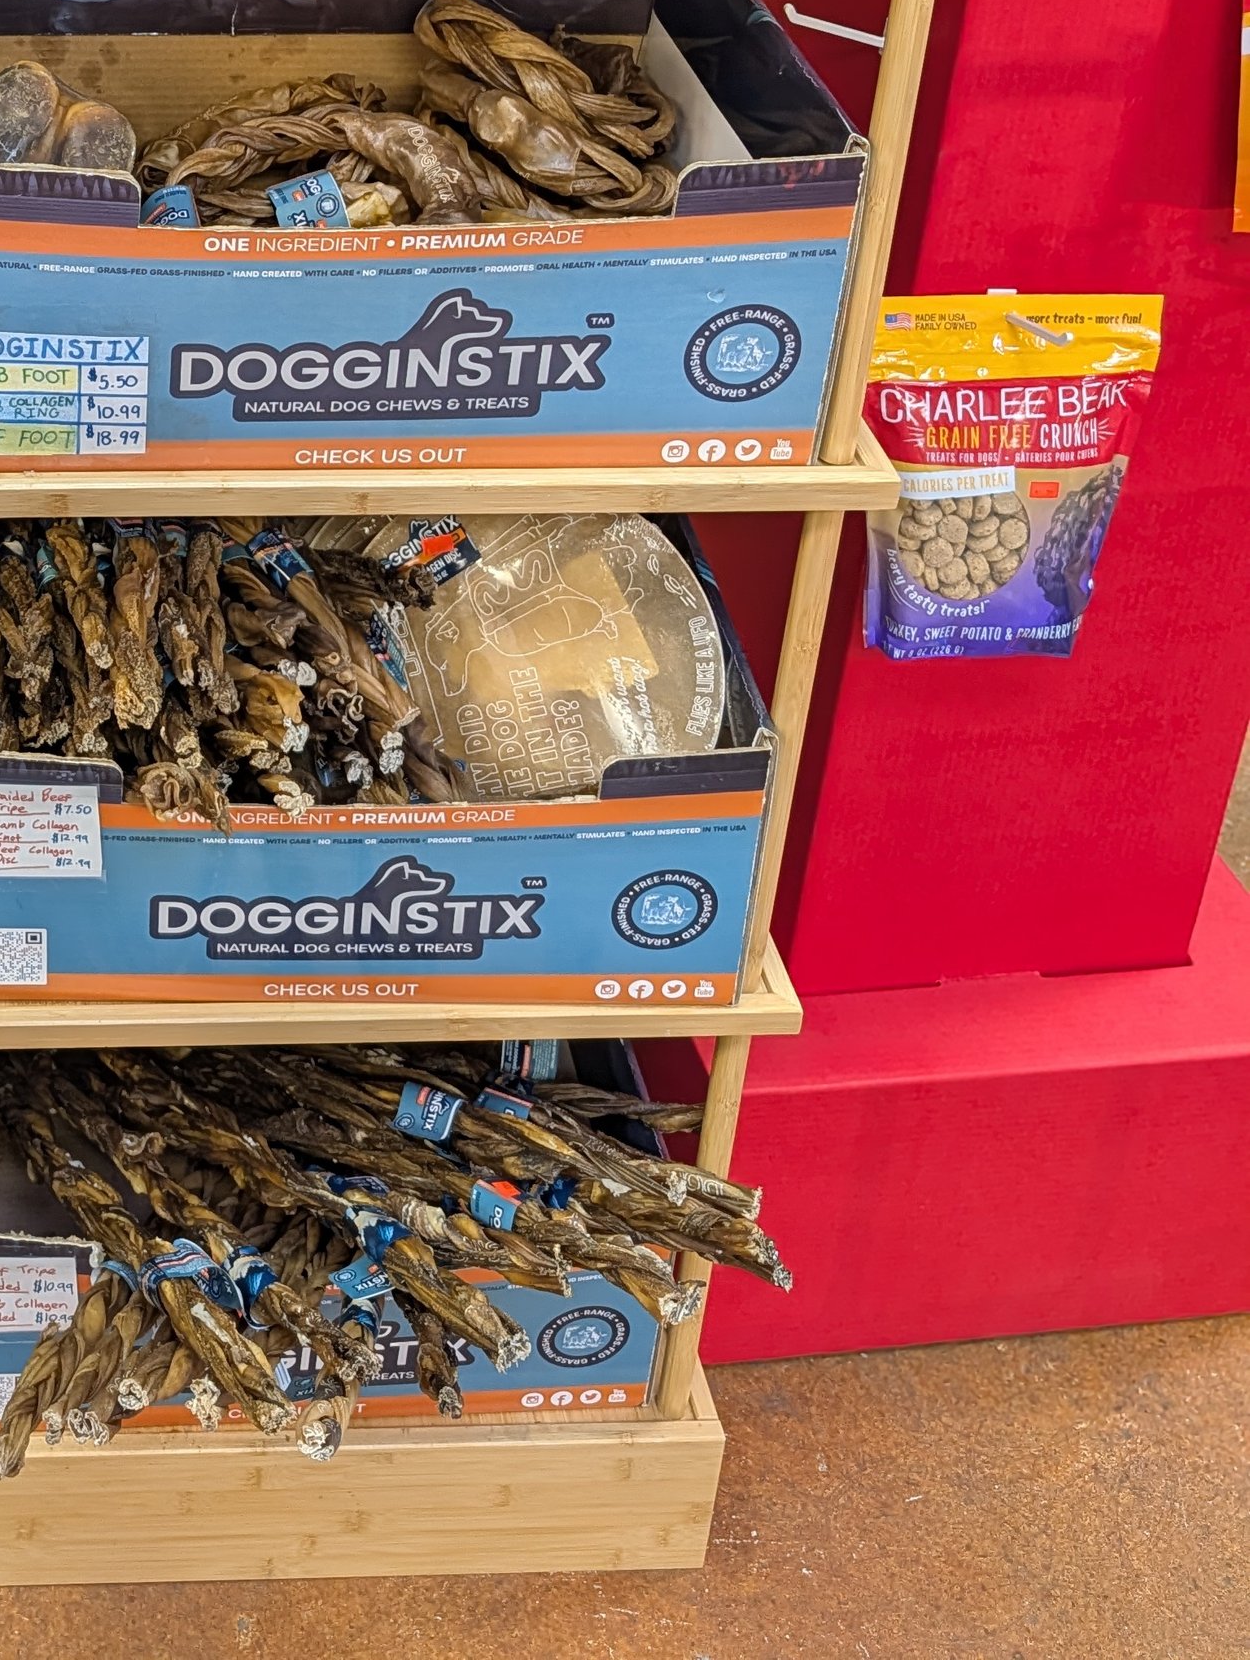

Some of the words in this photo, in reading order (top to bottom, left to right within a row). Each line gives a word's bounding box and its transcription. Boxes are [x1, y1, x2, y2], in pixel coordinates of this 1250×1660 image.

[21, 368, 72, 386] FOOT
[87, 367, 139, 390] $5.50
[178, 342, 602, 392] DOGGINSTIX
[8, 395, 76, 410] COLLAGEN
[14, 408, 61, 420] RING
[86, 396, 142, 420] $10.99
[880, 385, 1050, 425] CHARLEE
[1057, 378, 1129, 417] BEAR
[18, 429, 76, 448] FOOT
[85, 423, 141, 447] $18.99
[925, 425, 981, 450] GRAIN
[989, 424, 1033, 449] FREE
[1038, 418, 1099, 448] CRUNCH
[294, 448, 375, 465] CHECK
[380, 448, 413, 465] US
[418, 447, 467, 464] OUT
[688, 615, 712, 641] UFO
[695, 660, 714, 694] LIKE
[685, 696, 713, 737] FLIES
[41, 787, 73, 803] Beef
[54, 803, 92, 816] $7.50
[32, 818, 79, 833] Collagen
[52, 832, 89, 845] $12.99
[29, 844, 74, 858] Collagen
[157, 898, 537, 935] DOGGINSTIX
[33, 1279, 75, 1296] $10.99
[14, 1296, 69, 1311] Collagen
